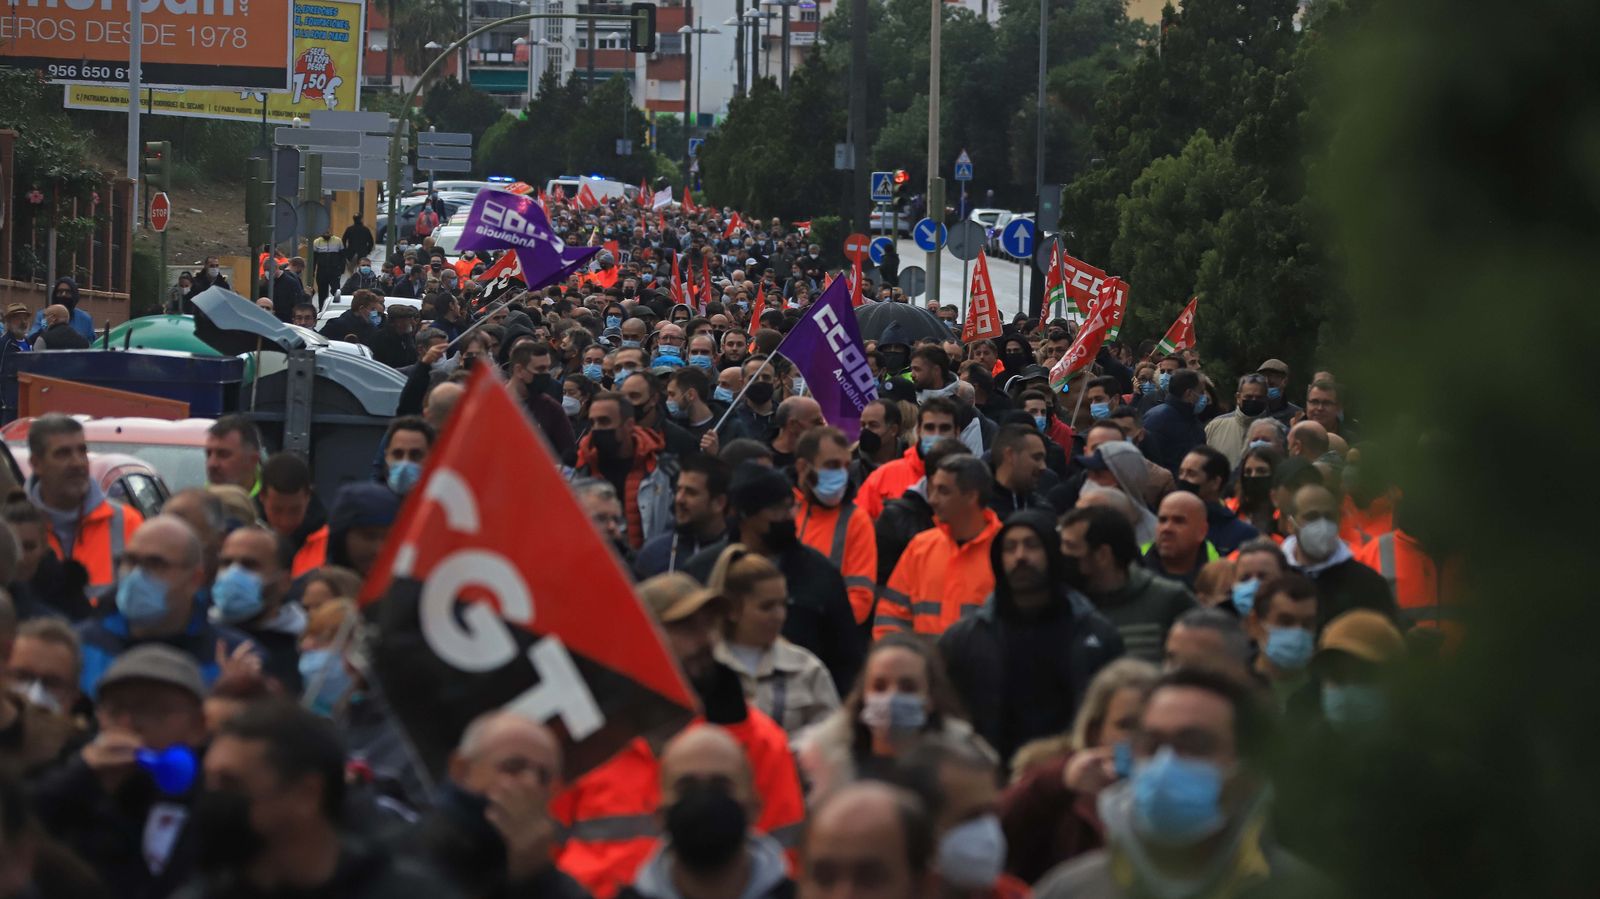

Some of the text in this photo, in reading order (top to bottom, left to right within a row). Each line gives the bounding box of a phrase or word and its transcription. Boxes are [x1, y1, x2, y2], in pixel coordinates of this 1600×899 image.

[186, 25, 248, 49] 1978
[48, 64, 143, 80] 956 650 61
[152, 208, 167, 218] STOP
[833, 368, 865, 412] Andaluc
